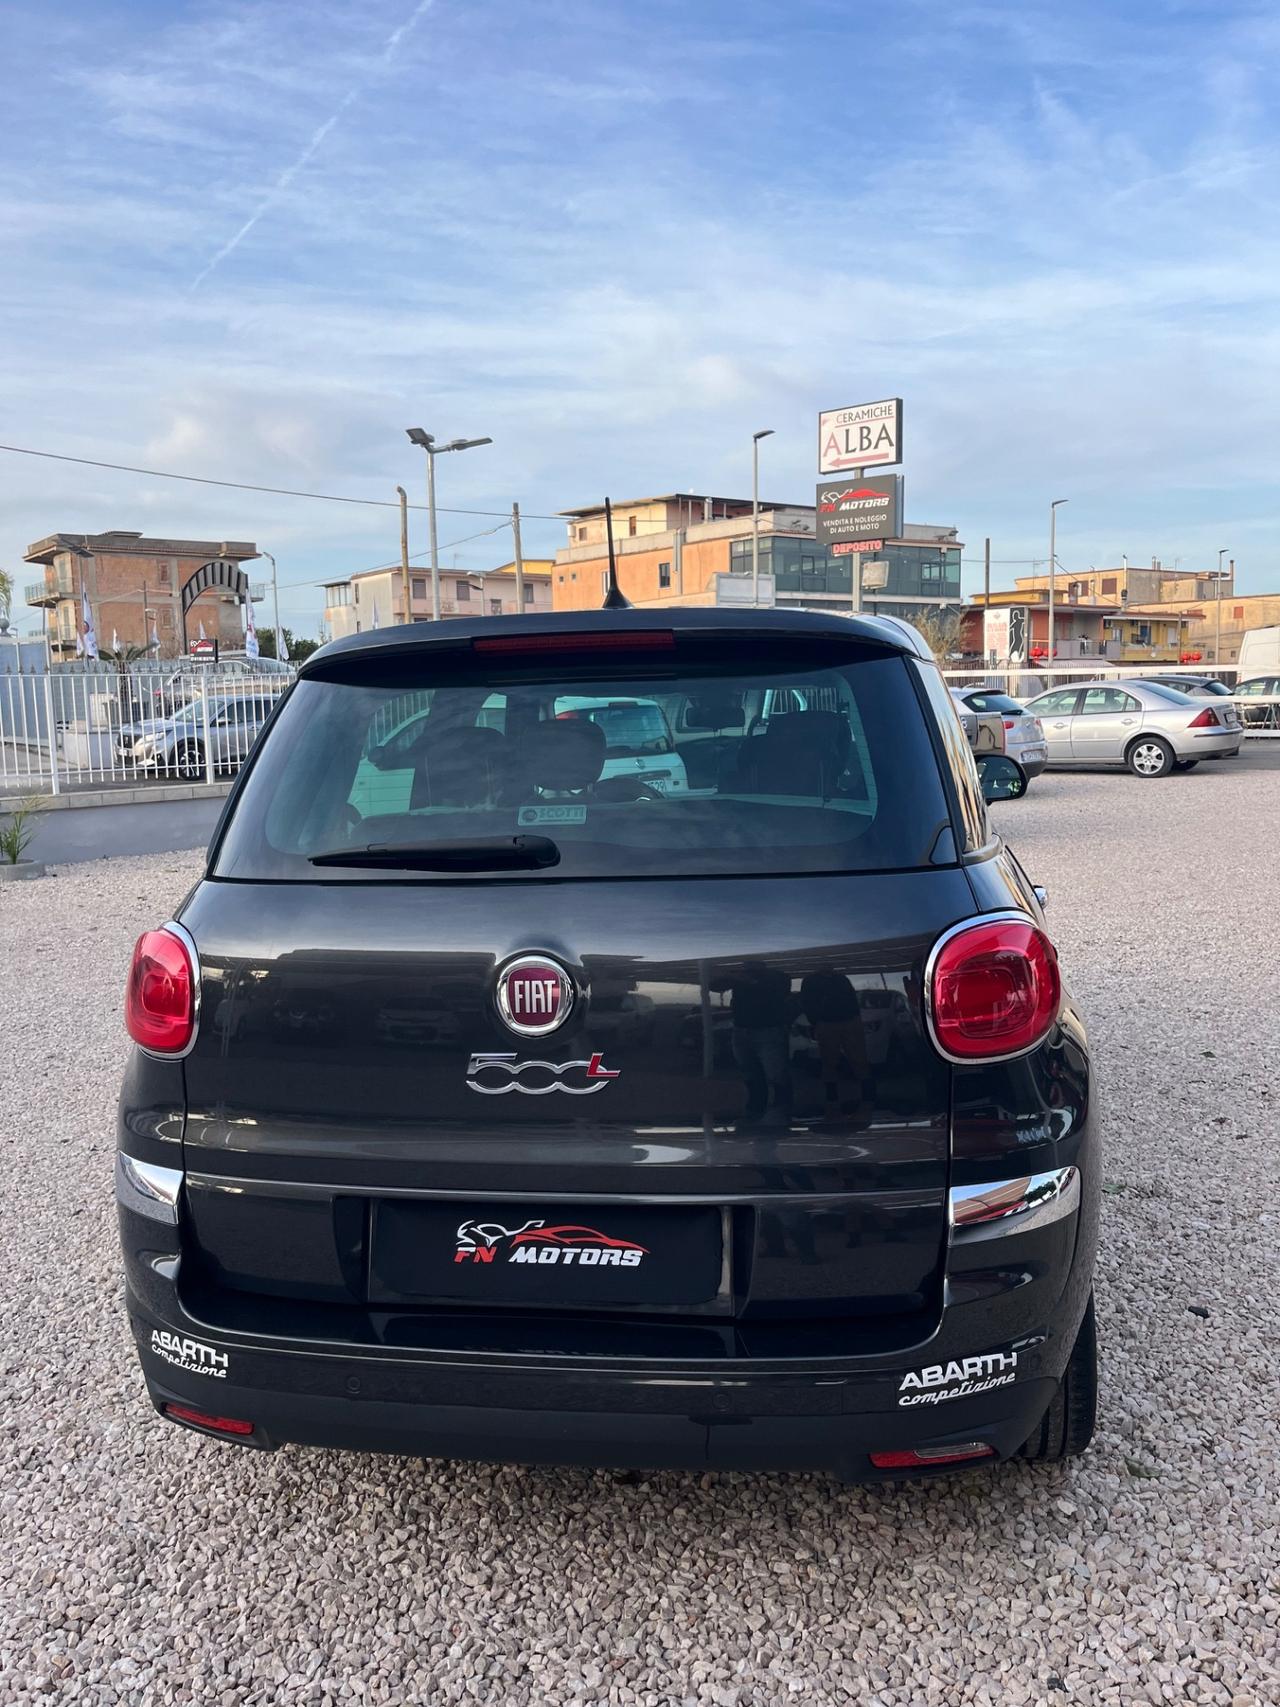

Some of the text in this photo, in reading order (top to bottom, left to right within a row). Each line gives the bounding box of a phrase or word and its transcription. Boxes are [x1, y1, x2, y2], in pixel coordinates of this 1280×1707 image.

[836, 405, 893, 423] CERAMICHE
[823, 423, 894, 457] ALBA
[819, 497, 890, 512] FN MOTORS
[822, 518, 849, 527] VENDITA
[854, 514, 887, 523] NOLEGGIO
[837, 525, 855, 533] AUTO
[860, 523, 880, 531] MOTO
[832, 540, 882, 553] DEPOSITO
[514, 980, 556, 1014] FIAT
[465, 1052, 621, 1095] 500L
[454, 1246, 643, 1266] FN MOTORS
[151, 1330, 228, 1367] ABARTH
[151, 1344, 226, 1378] competizione
[899, 1352, 1017, 1390] ABARTH
[898, 1371, 1016, 1406] competizione
